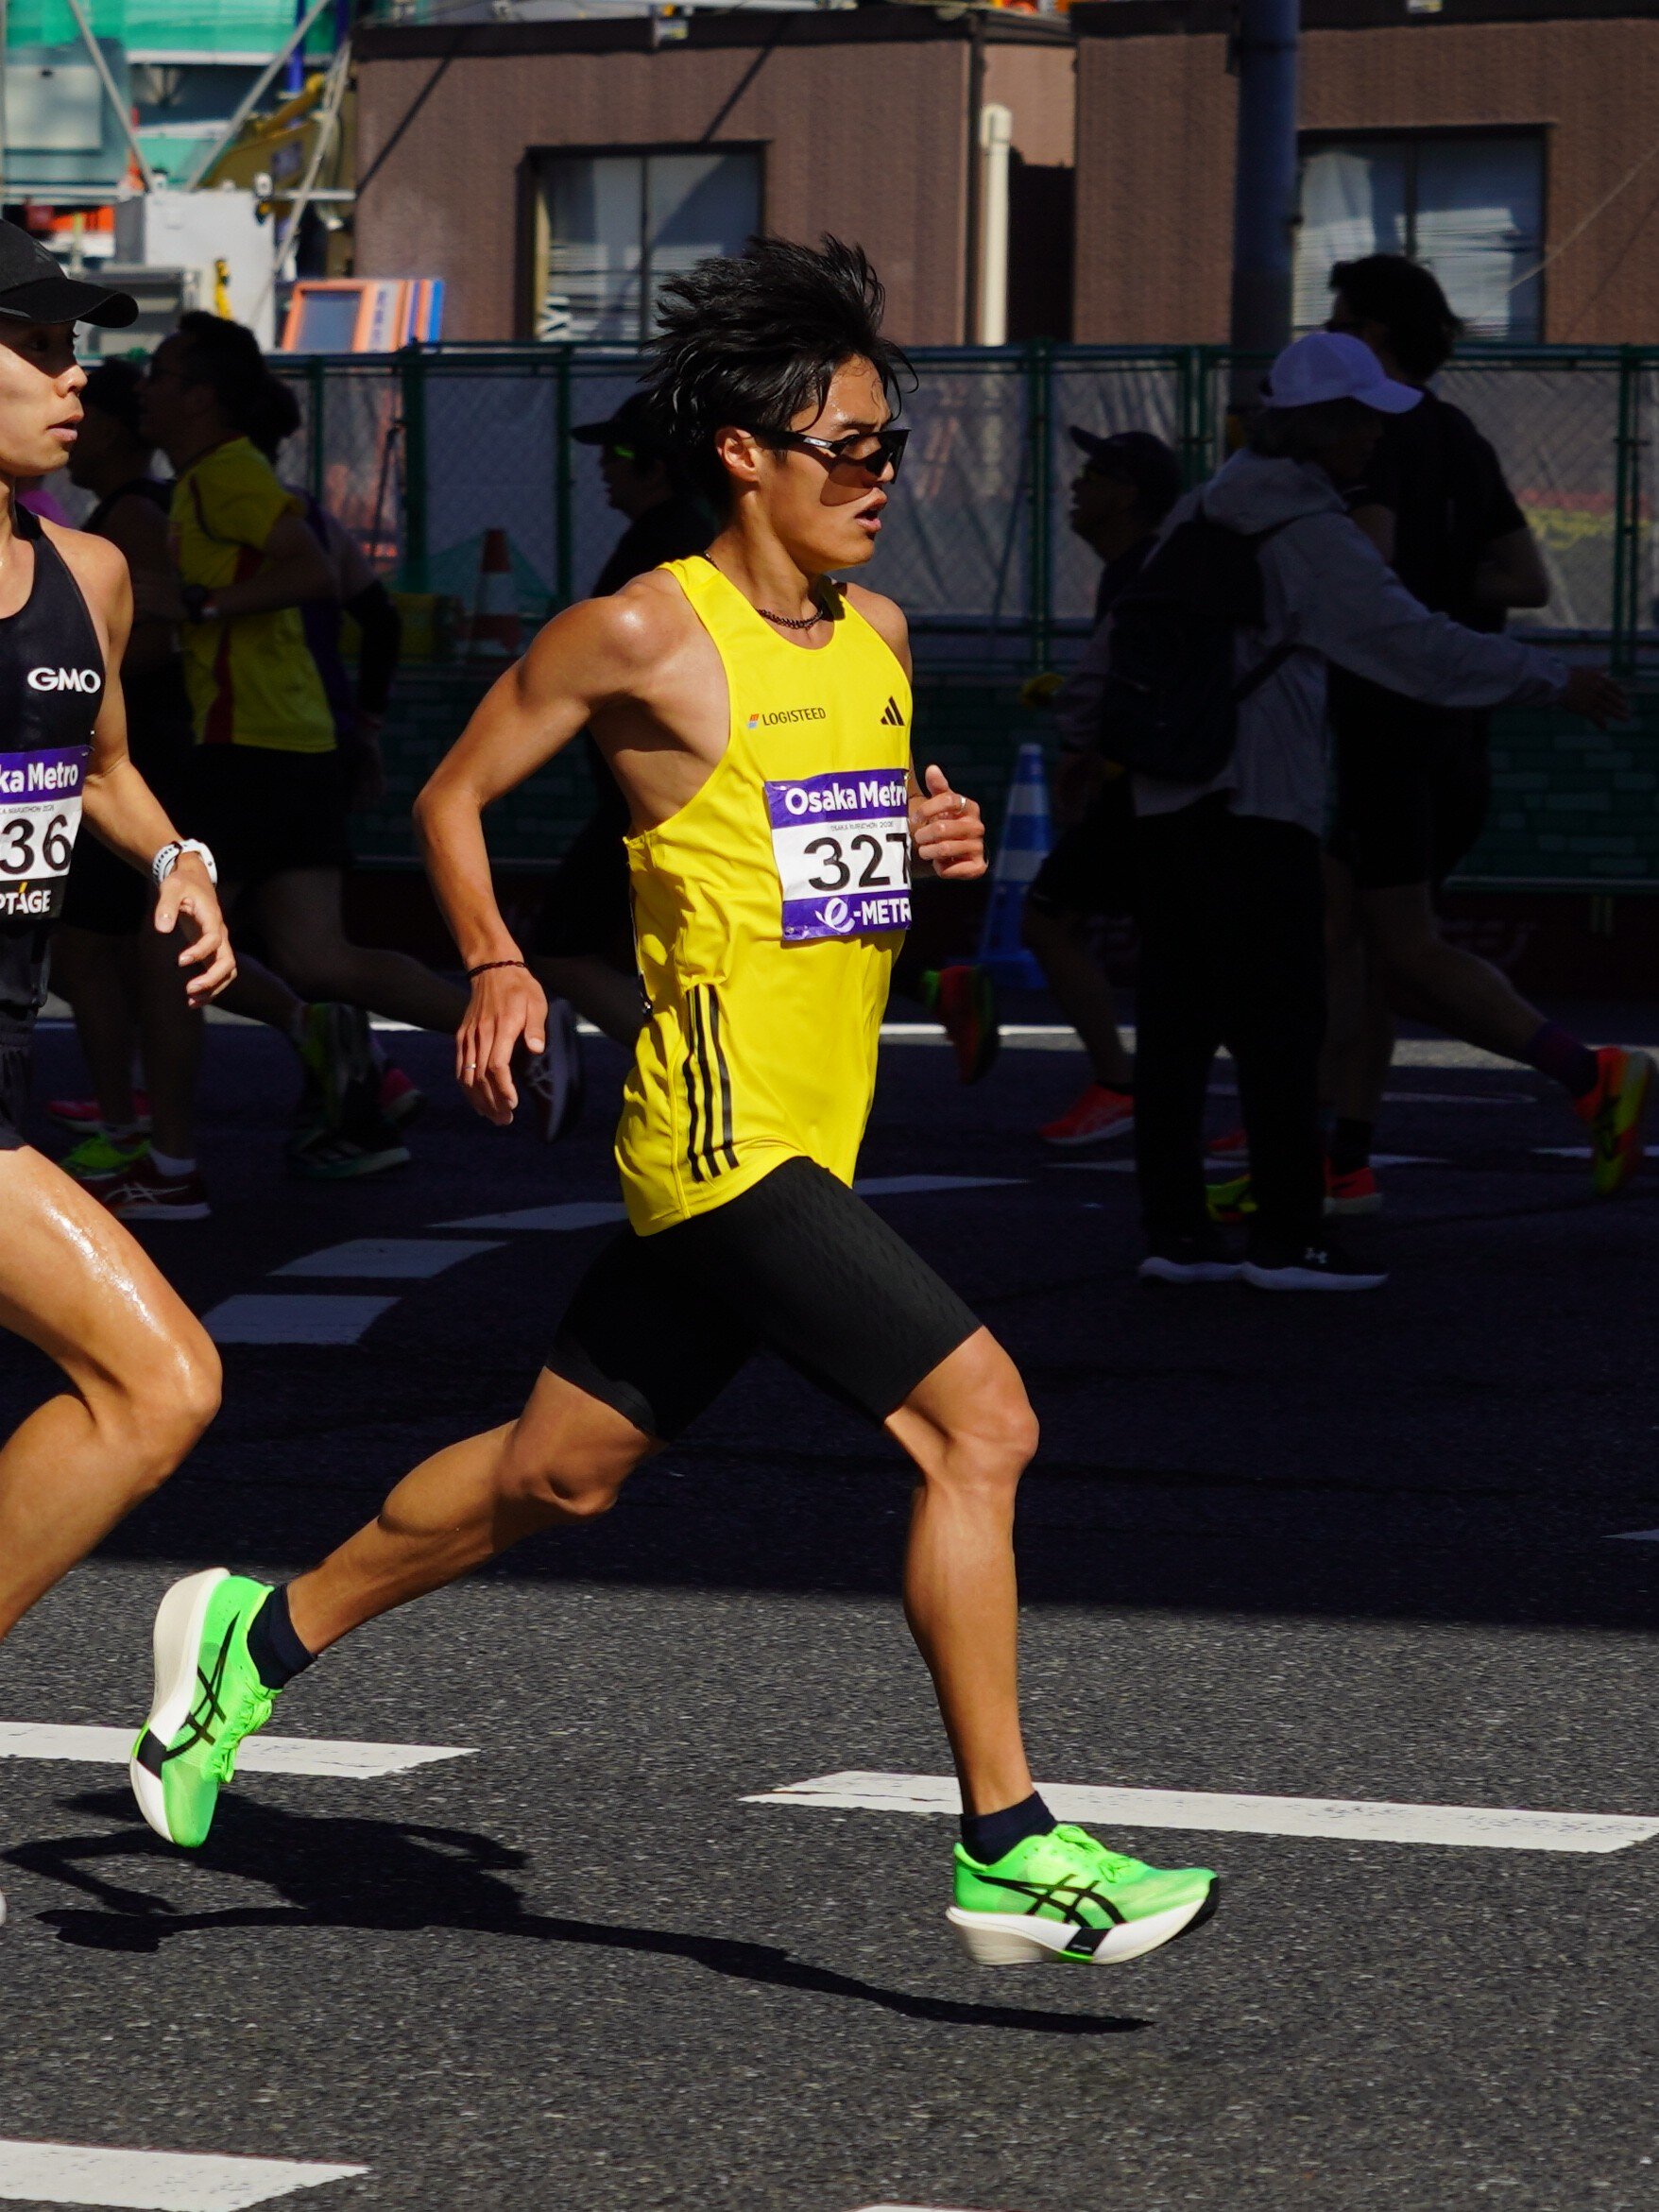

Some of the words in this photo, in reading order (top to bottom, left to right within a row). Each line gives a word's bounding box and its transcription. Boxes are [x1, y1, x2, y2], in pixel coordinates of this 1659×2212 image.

[27, 667, 101, 694] GMO
[761, 707, 827, 727] LOGISTEED
[27, 762, 78, 792] Metro
[784, 782, 858, 815] Osaka
[0, 814, 72, 875] 36
